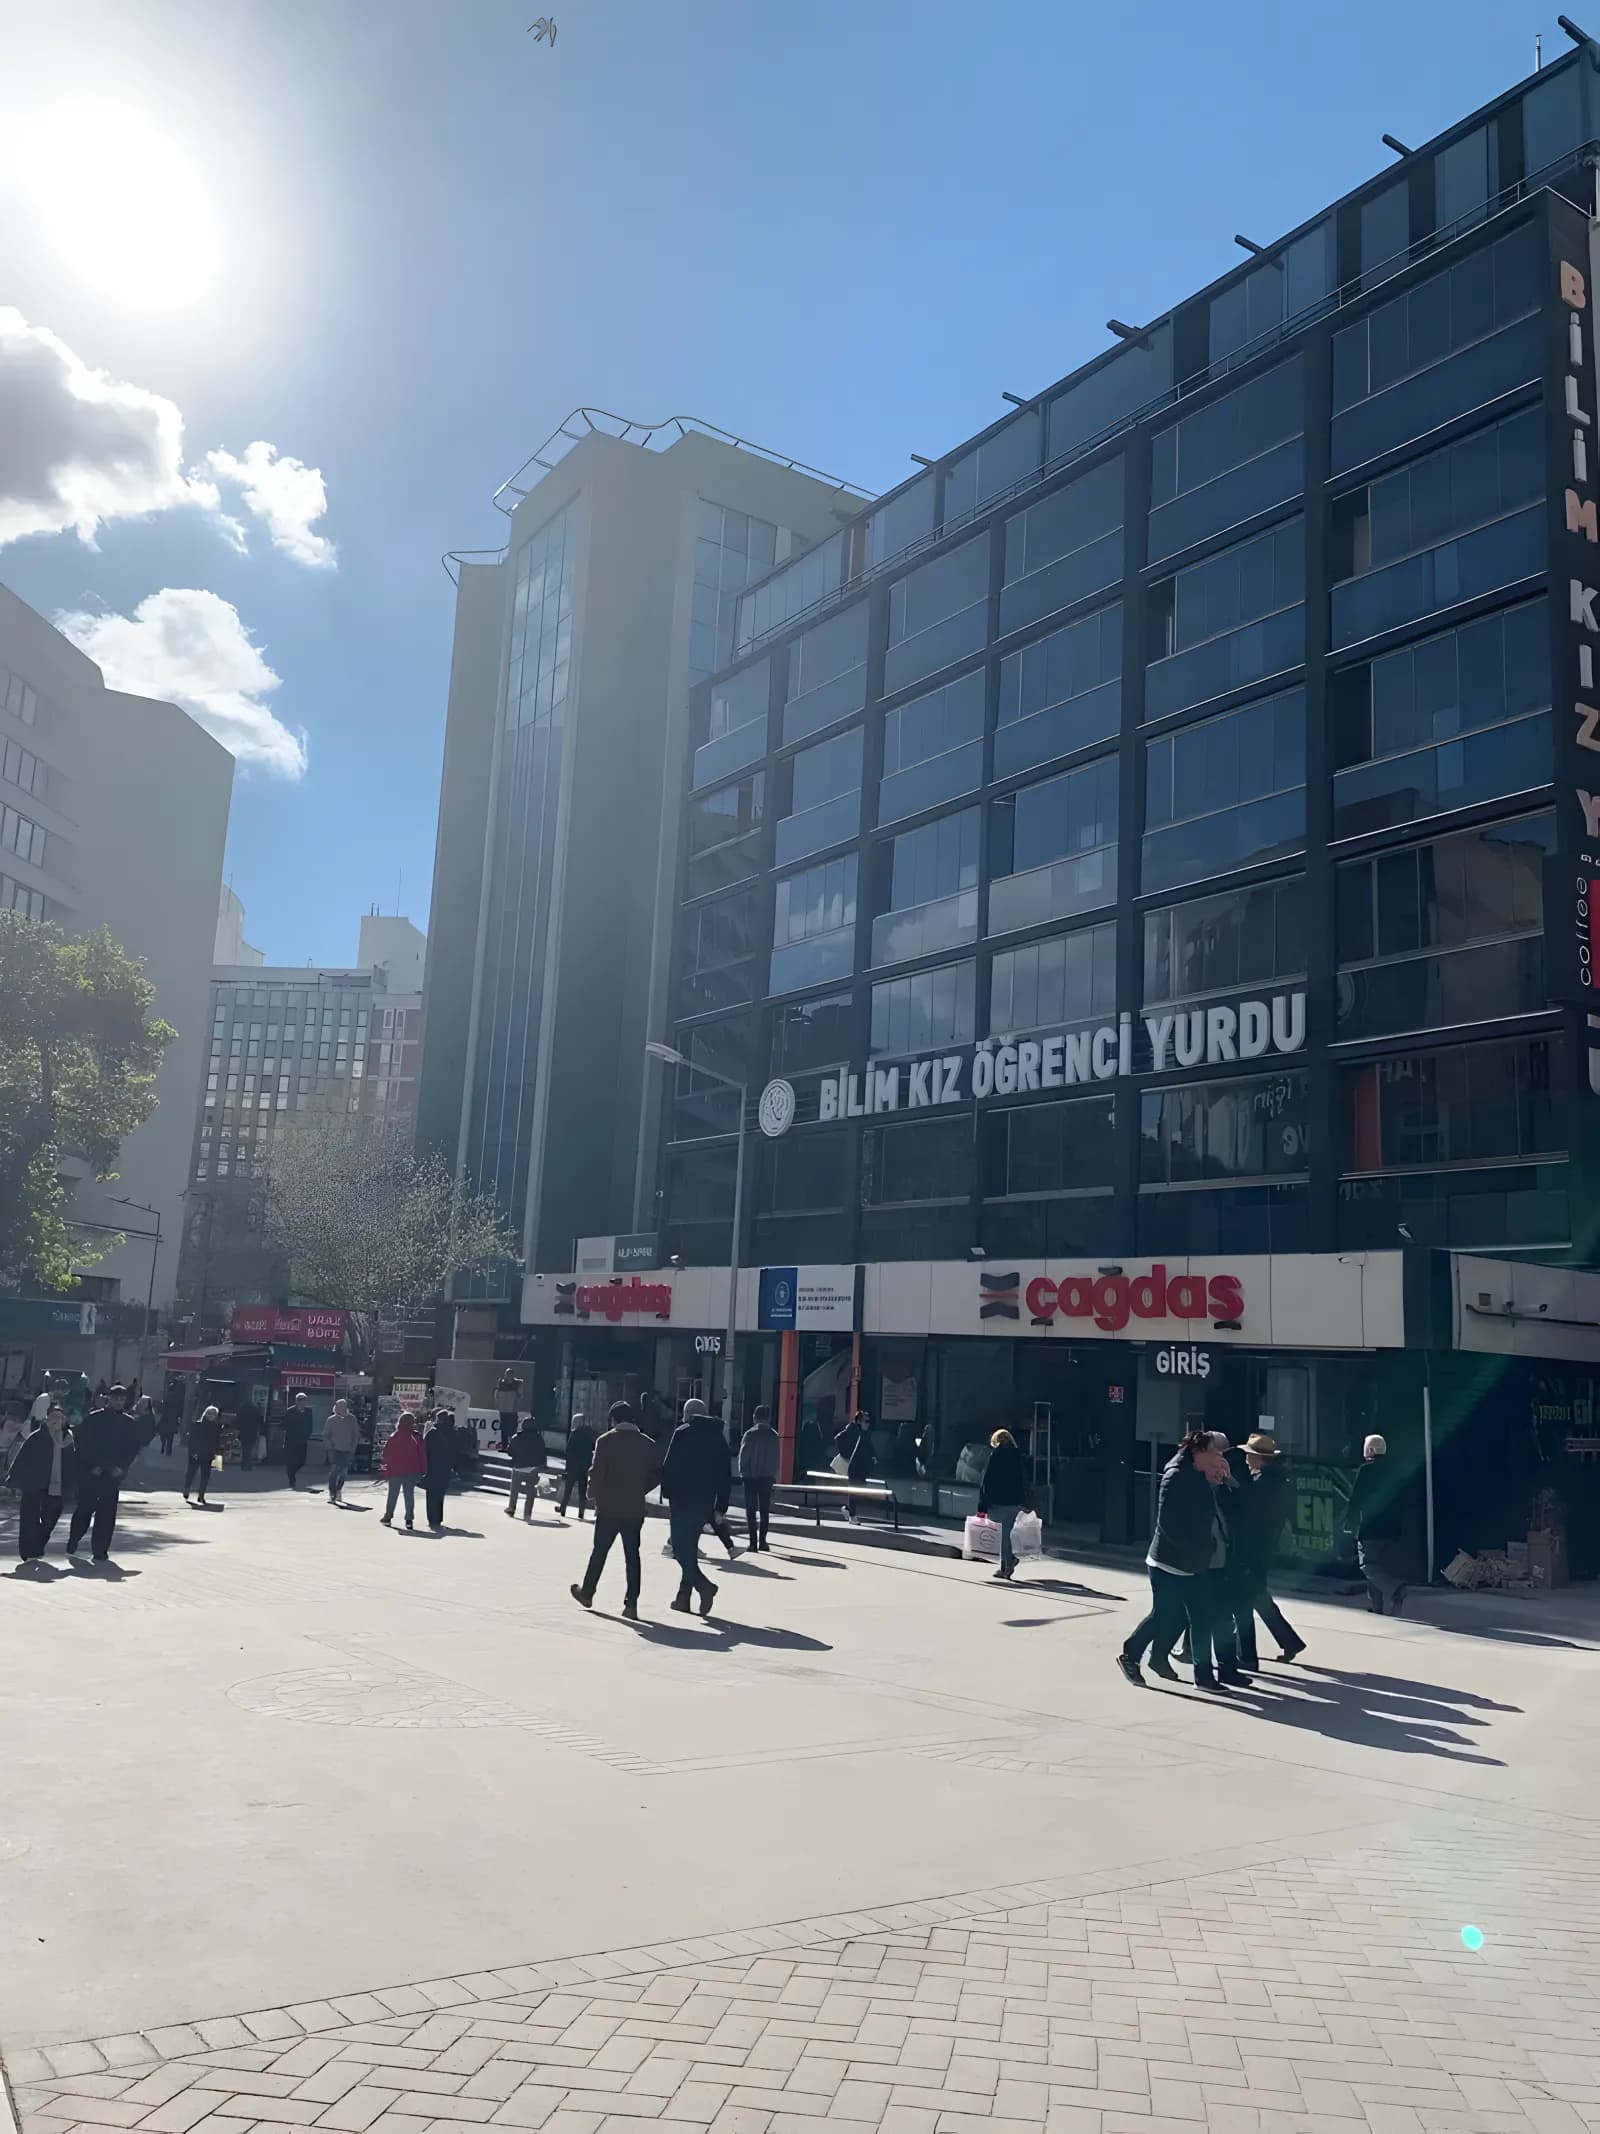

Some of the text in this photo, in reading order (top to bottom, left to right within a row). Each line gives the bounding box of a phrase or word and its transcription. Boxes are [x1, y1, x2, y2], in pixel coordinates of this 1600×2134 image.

[819, 993, 1306, 1120] BİLİM KIZ ÖĞRENCİ YURDU
[1026, 1264, 1244, 1331] çağdaş
[1156, 1346, 1211, 1378] GİRİŞ
